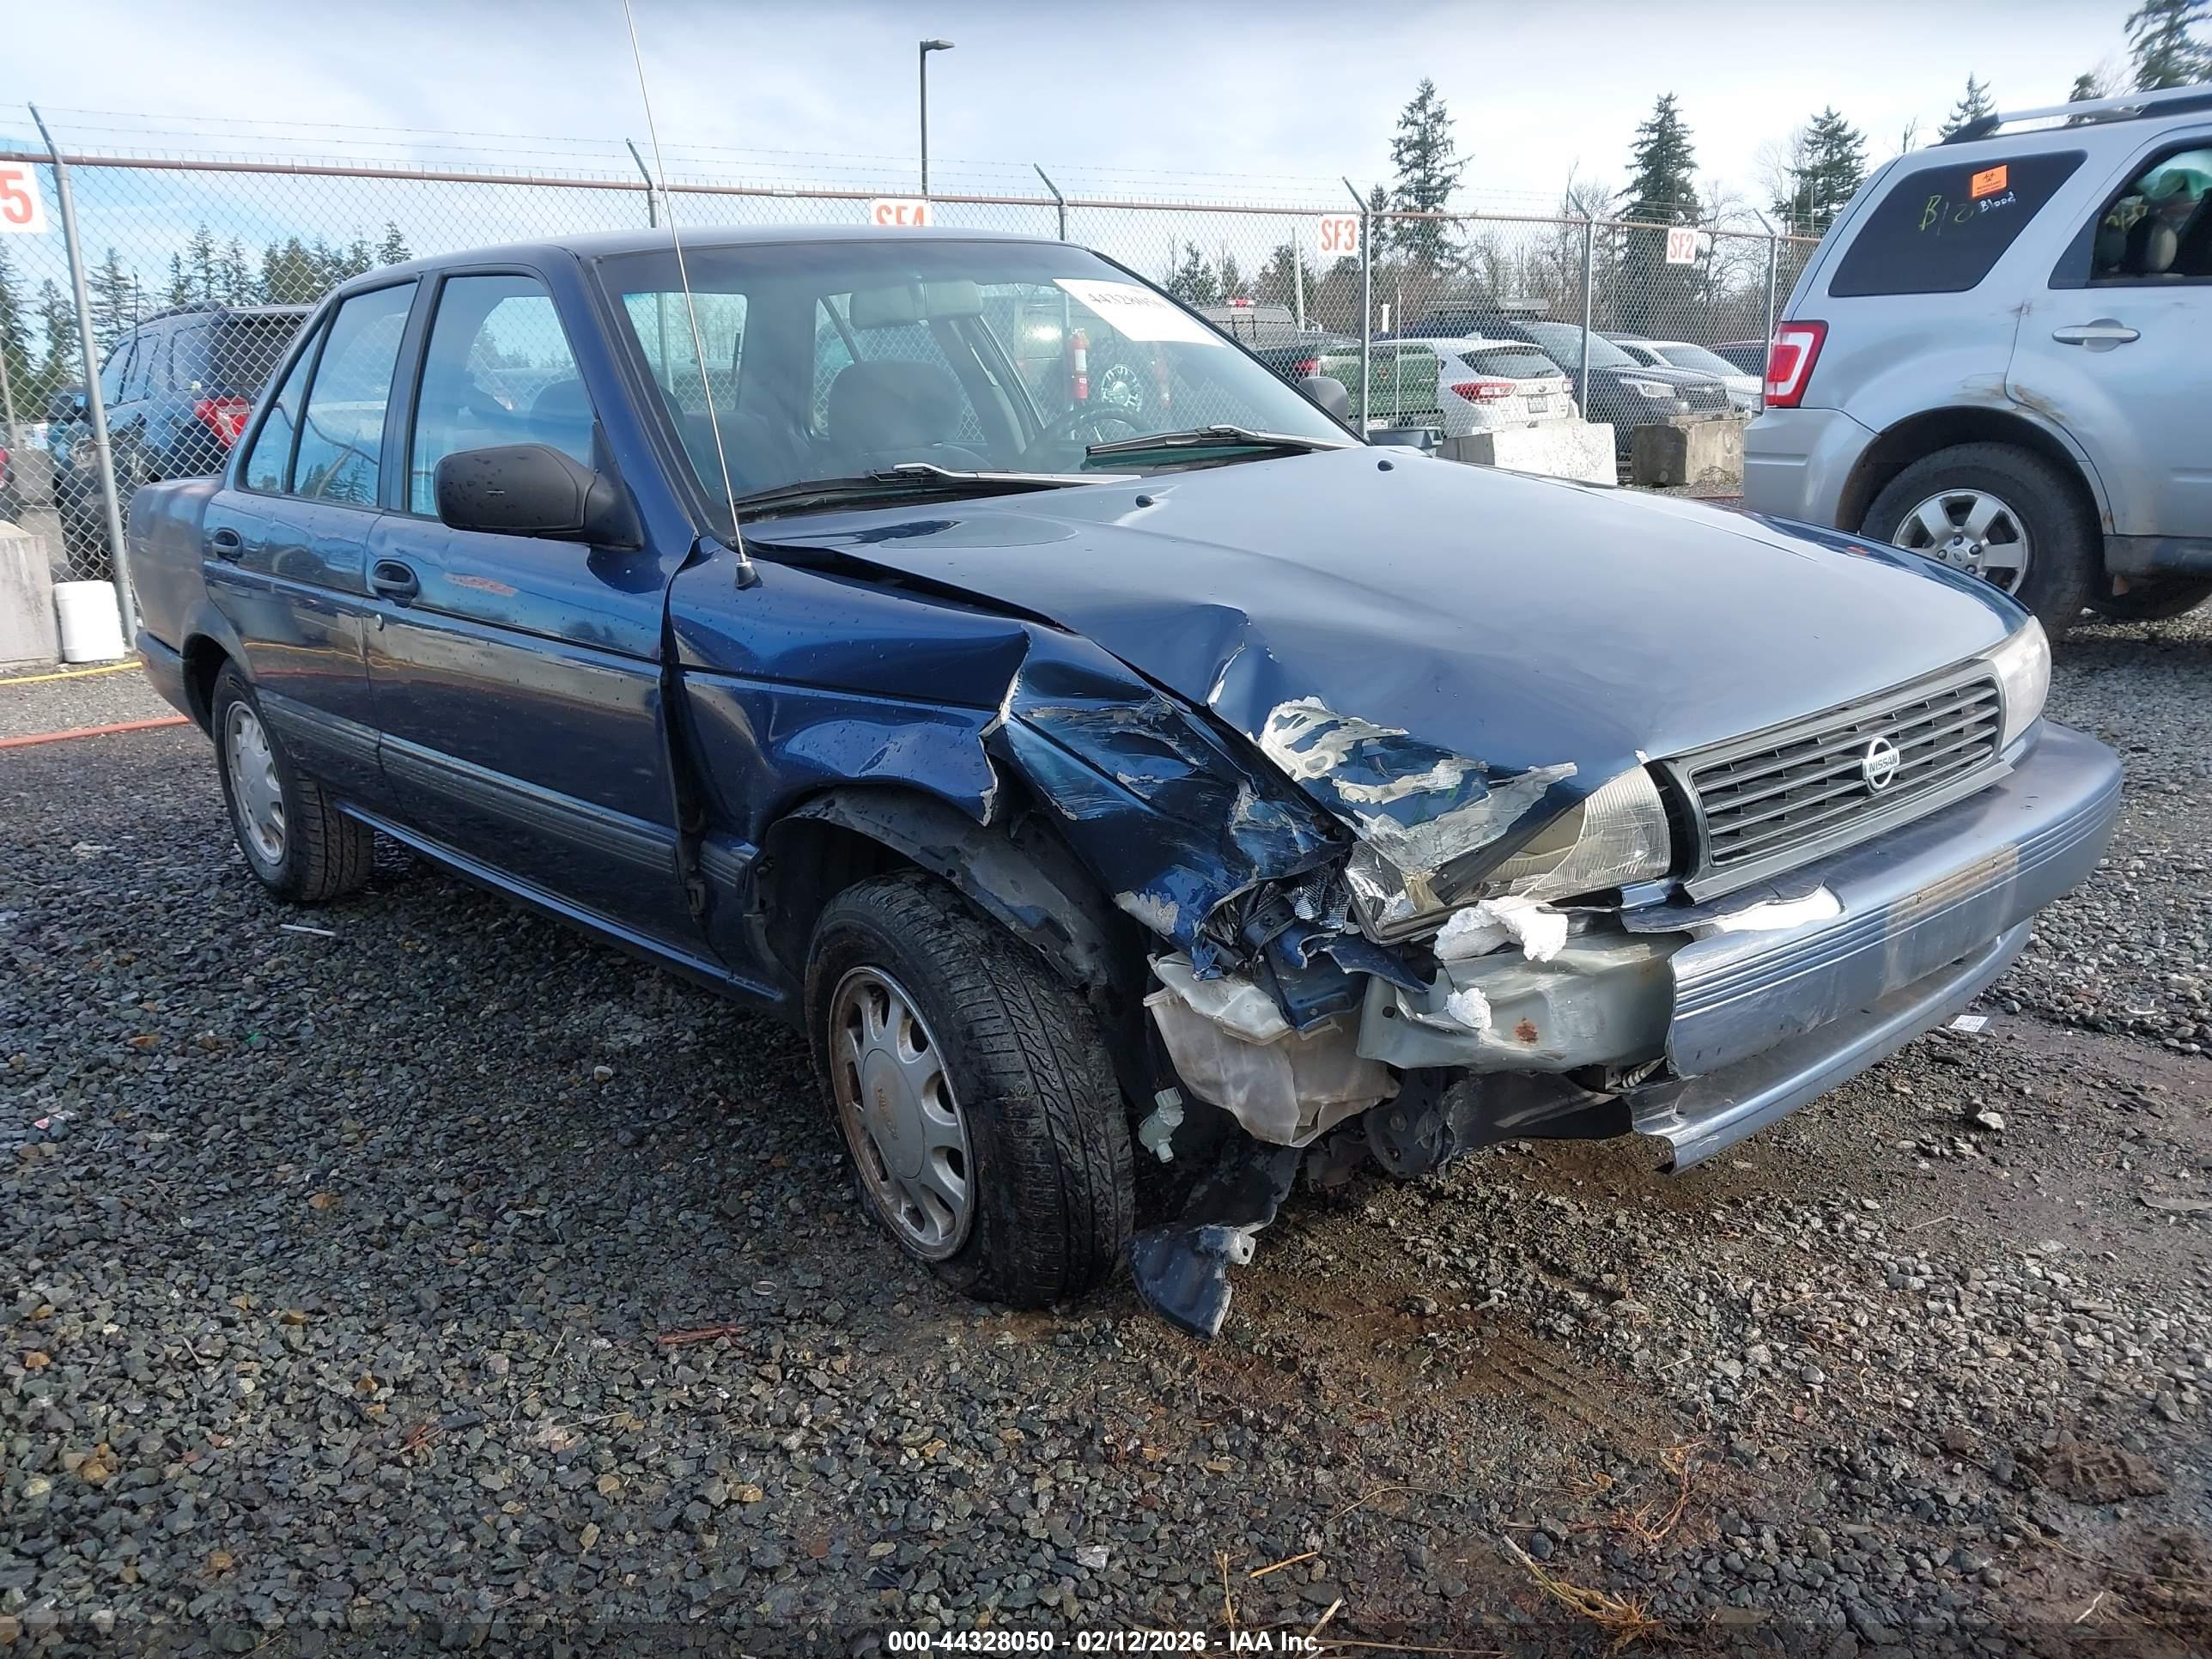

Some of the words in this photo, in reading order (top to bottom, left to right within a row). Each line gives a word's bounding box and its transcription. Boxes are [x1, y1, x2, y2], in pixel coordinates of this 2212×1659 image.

[0, 170, 33, 224] 5
[1979, 191, 2015, 212] Blood
[1321, 219, 1356, 252] SF3
[1669, 232, 1694, 259] SF2
[1869, 754, 1898, 773] NISSAN
